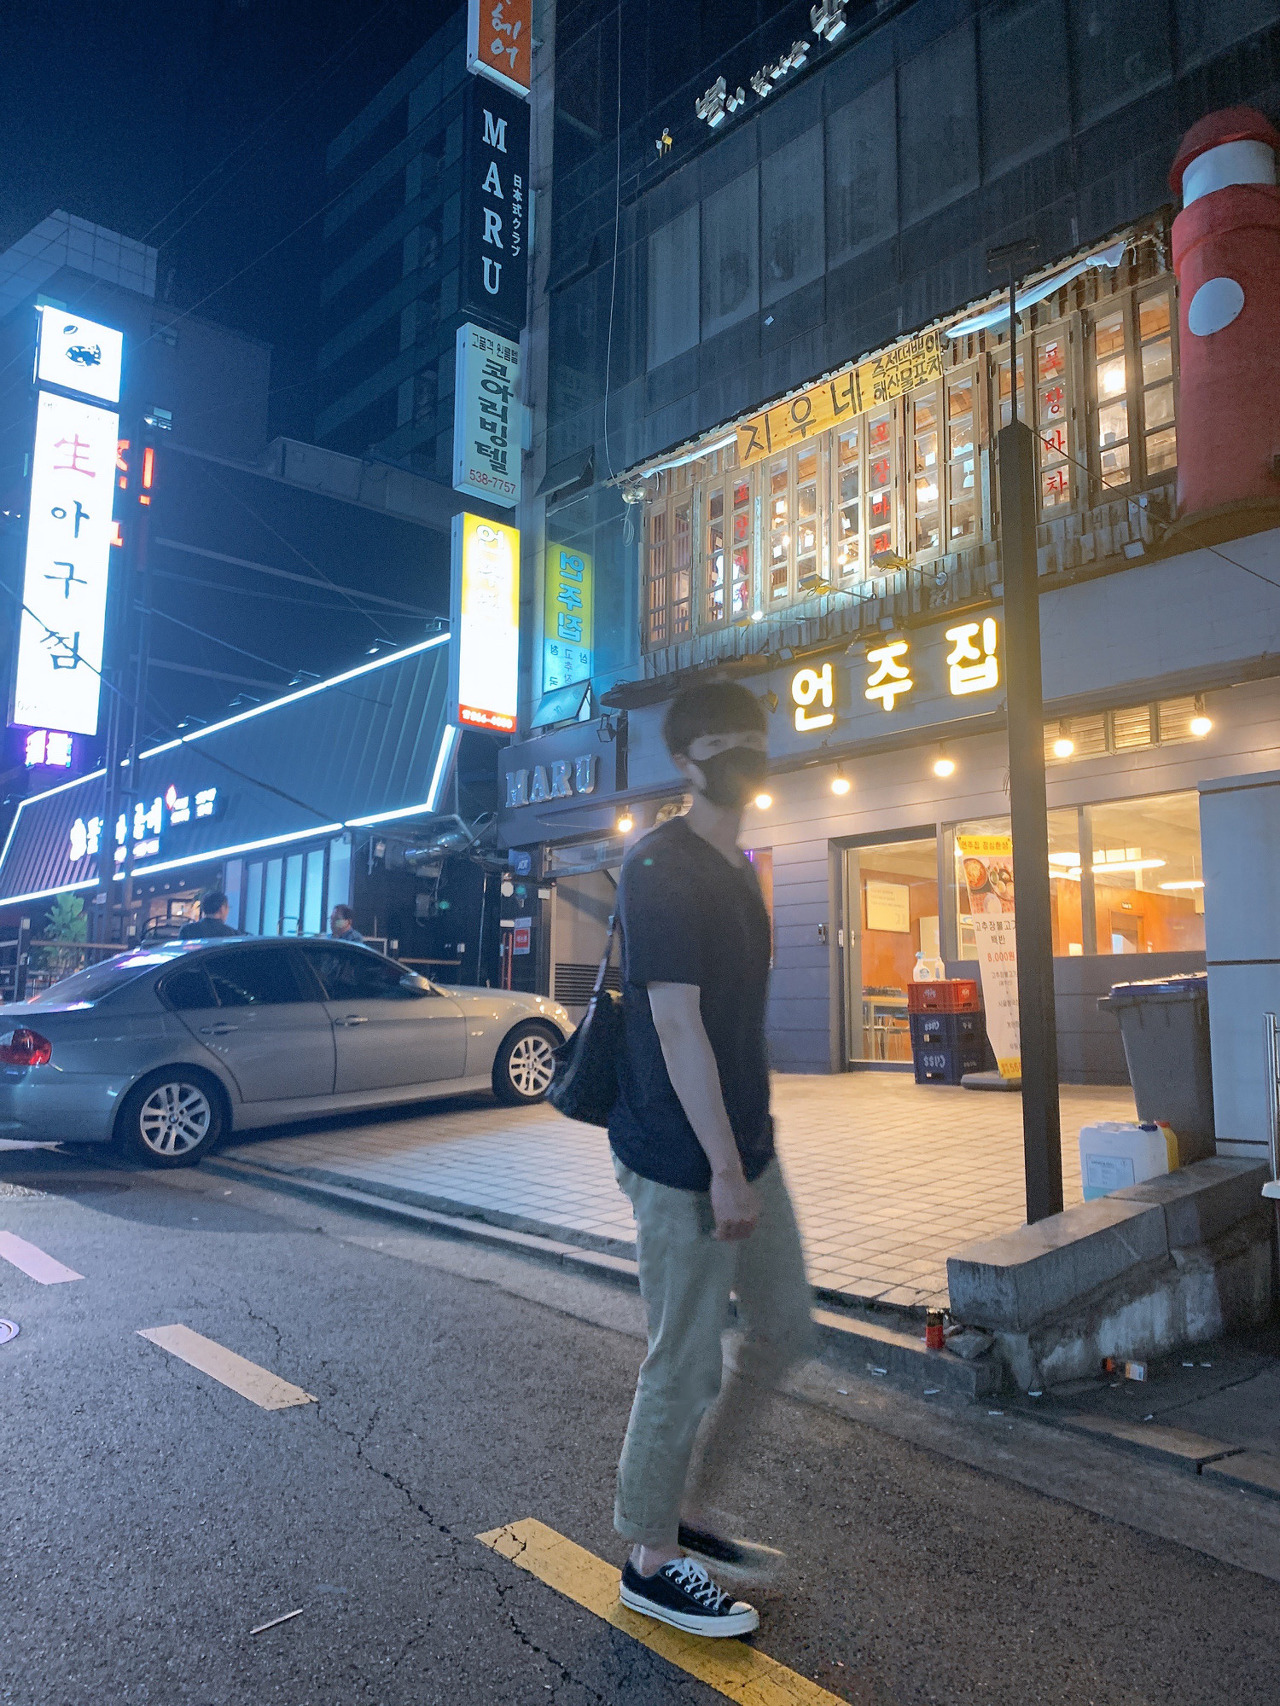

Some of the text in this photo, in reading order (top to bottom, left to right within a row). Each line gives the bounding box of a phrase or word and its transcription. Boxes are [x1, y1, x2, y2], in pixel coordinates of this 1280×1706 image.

[482, 108, 508, 295] MARU
[511, 173, 523, 257] 日本式クラブ
[471, 332, 494, 356] 고품격
[474, 358, 514, 476] 코아리빙텔
[739, 369, 863, 461] 지우네
[1041, 347, 1068, 495] 포장마차
[469, 468, 516, 495] 538-7757
[871, 422, 890, 555] 포장마차
[791, 616, 1000, 733] 언주집
[505, 754, 598, 808] MARU
